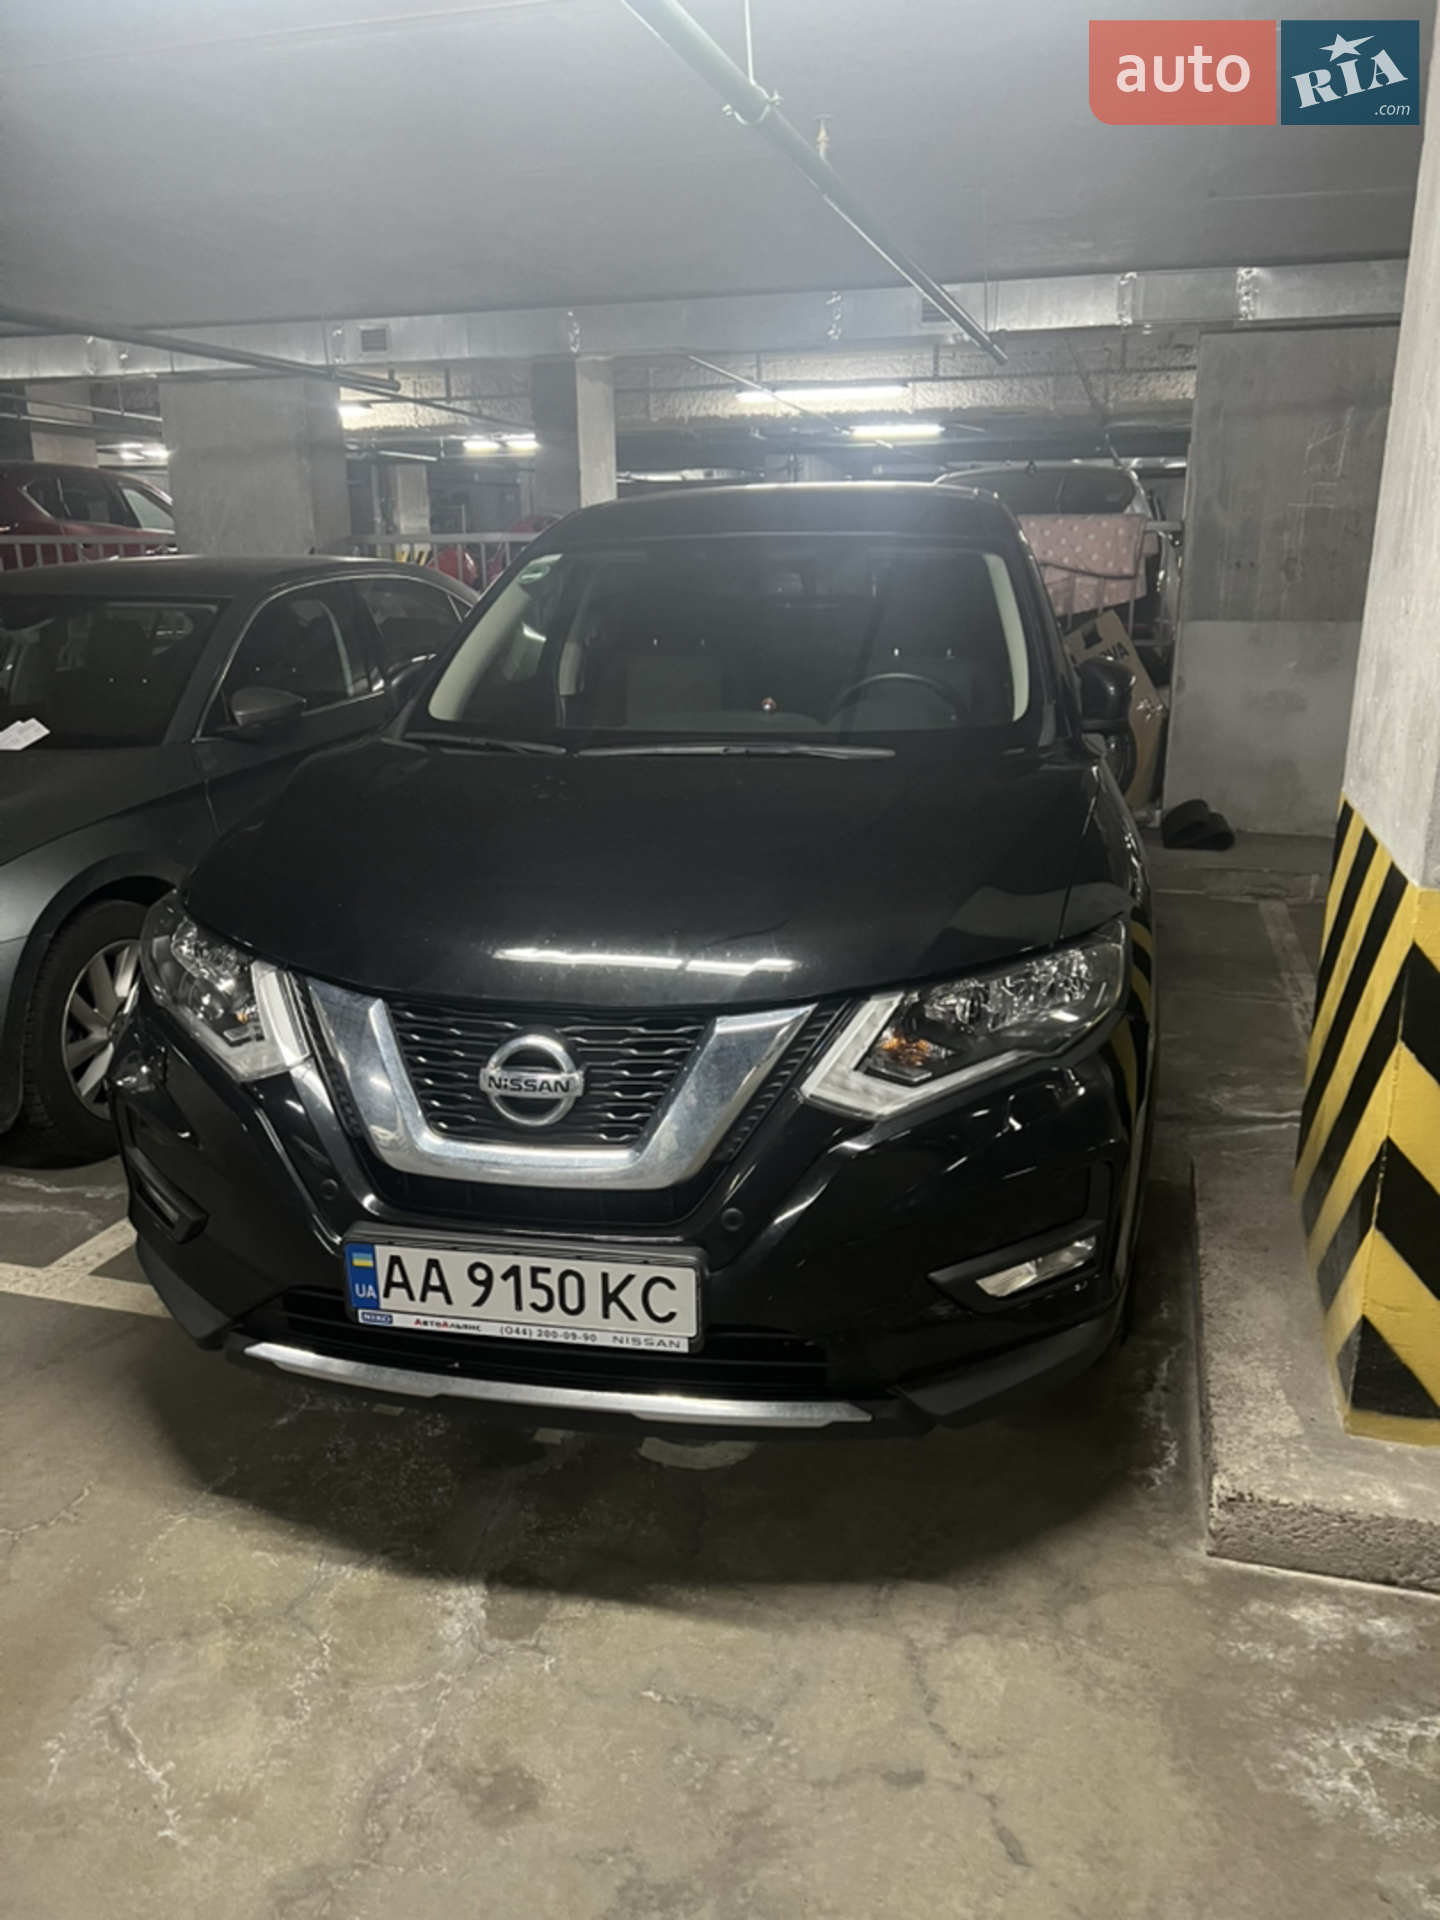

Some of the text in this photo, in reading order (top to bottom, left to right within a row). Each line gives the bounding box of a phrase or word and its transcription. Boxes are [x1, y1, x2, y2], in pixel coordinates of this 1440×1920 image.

[488, 1076, 570, 1093] NISSAN
[355, 1283, 377, 1299] UA
[382, 1254, 678, 1324] AA 9150 KC
[612, 1335, 681, 1349] NISSAN
